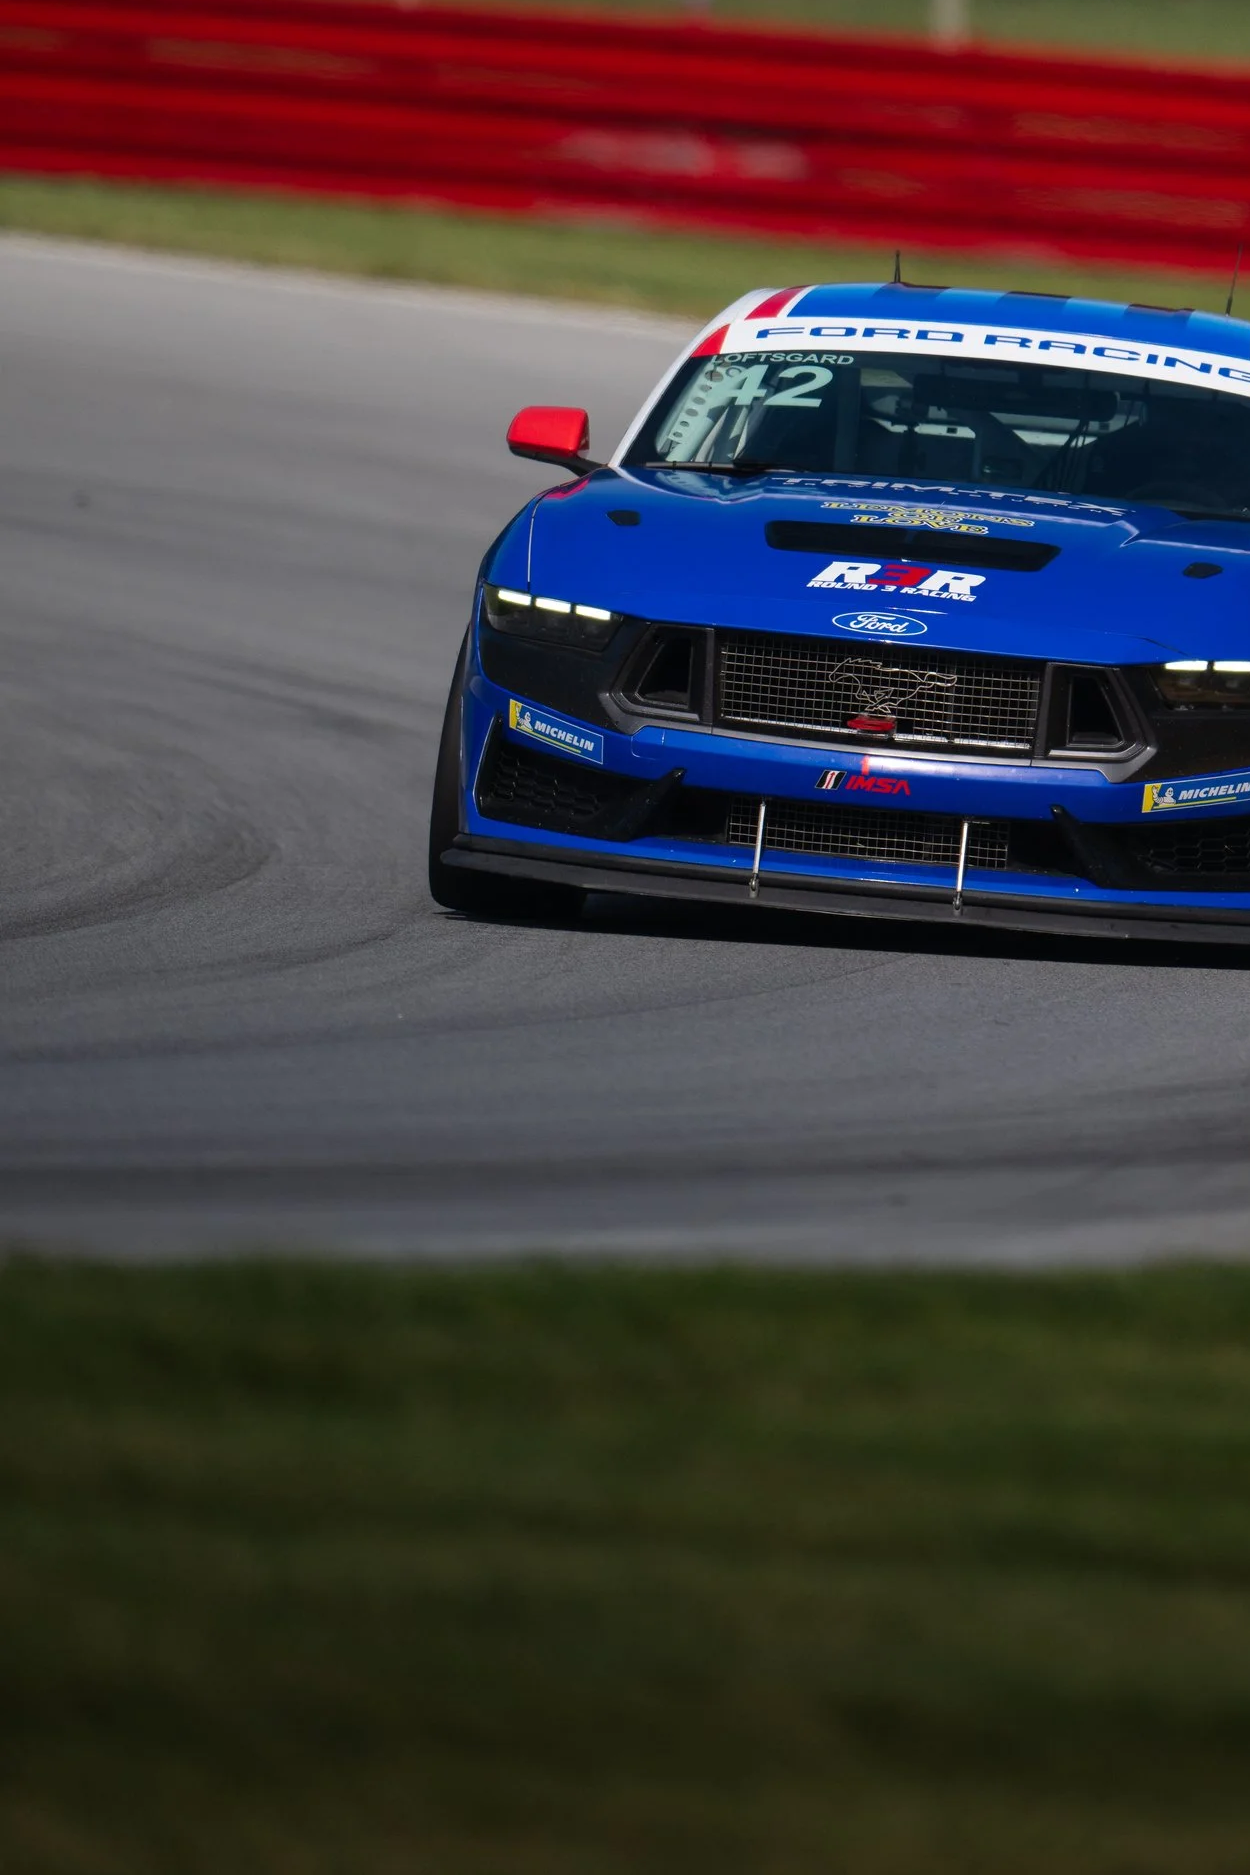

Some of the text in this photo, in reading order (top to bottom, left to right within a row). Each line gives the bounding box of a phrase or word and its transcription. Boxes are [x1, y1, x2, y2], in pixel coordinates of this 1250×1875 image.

[755, 326, 965, 343] FORD
[710, 352, 855, 366] LOFTSGARD
[730, 364, 834, 408] 42
[850, 514, 990, 535] LOVE
[811, 561, 986, 595] R3R
[806, 580, 977, 603] ROUND 3 RACING
[849, 613, 910, 634] Ford
[534, 720, 595, 752] MICHELIN
[845, 775, 912, 796] IMSA
